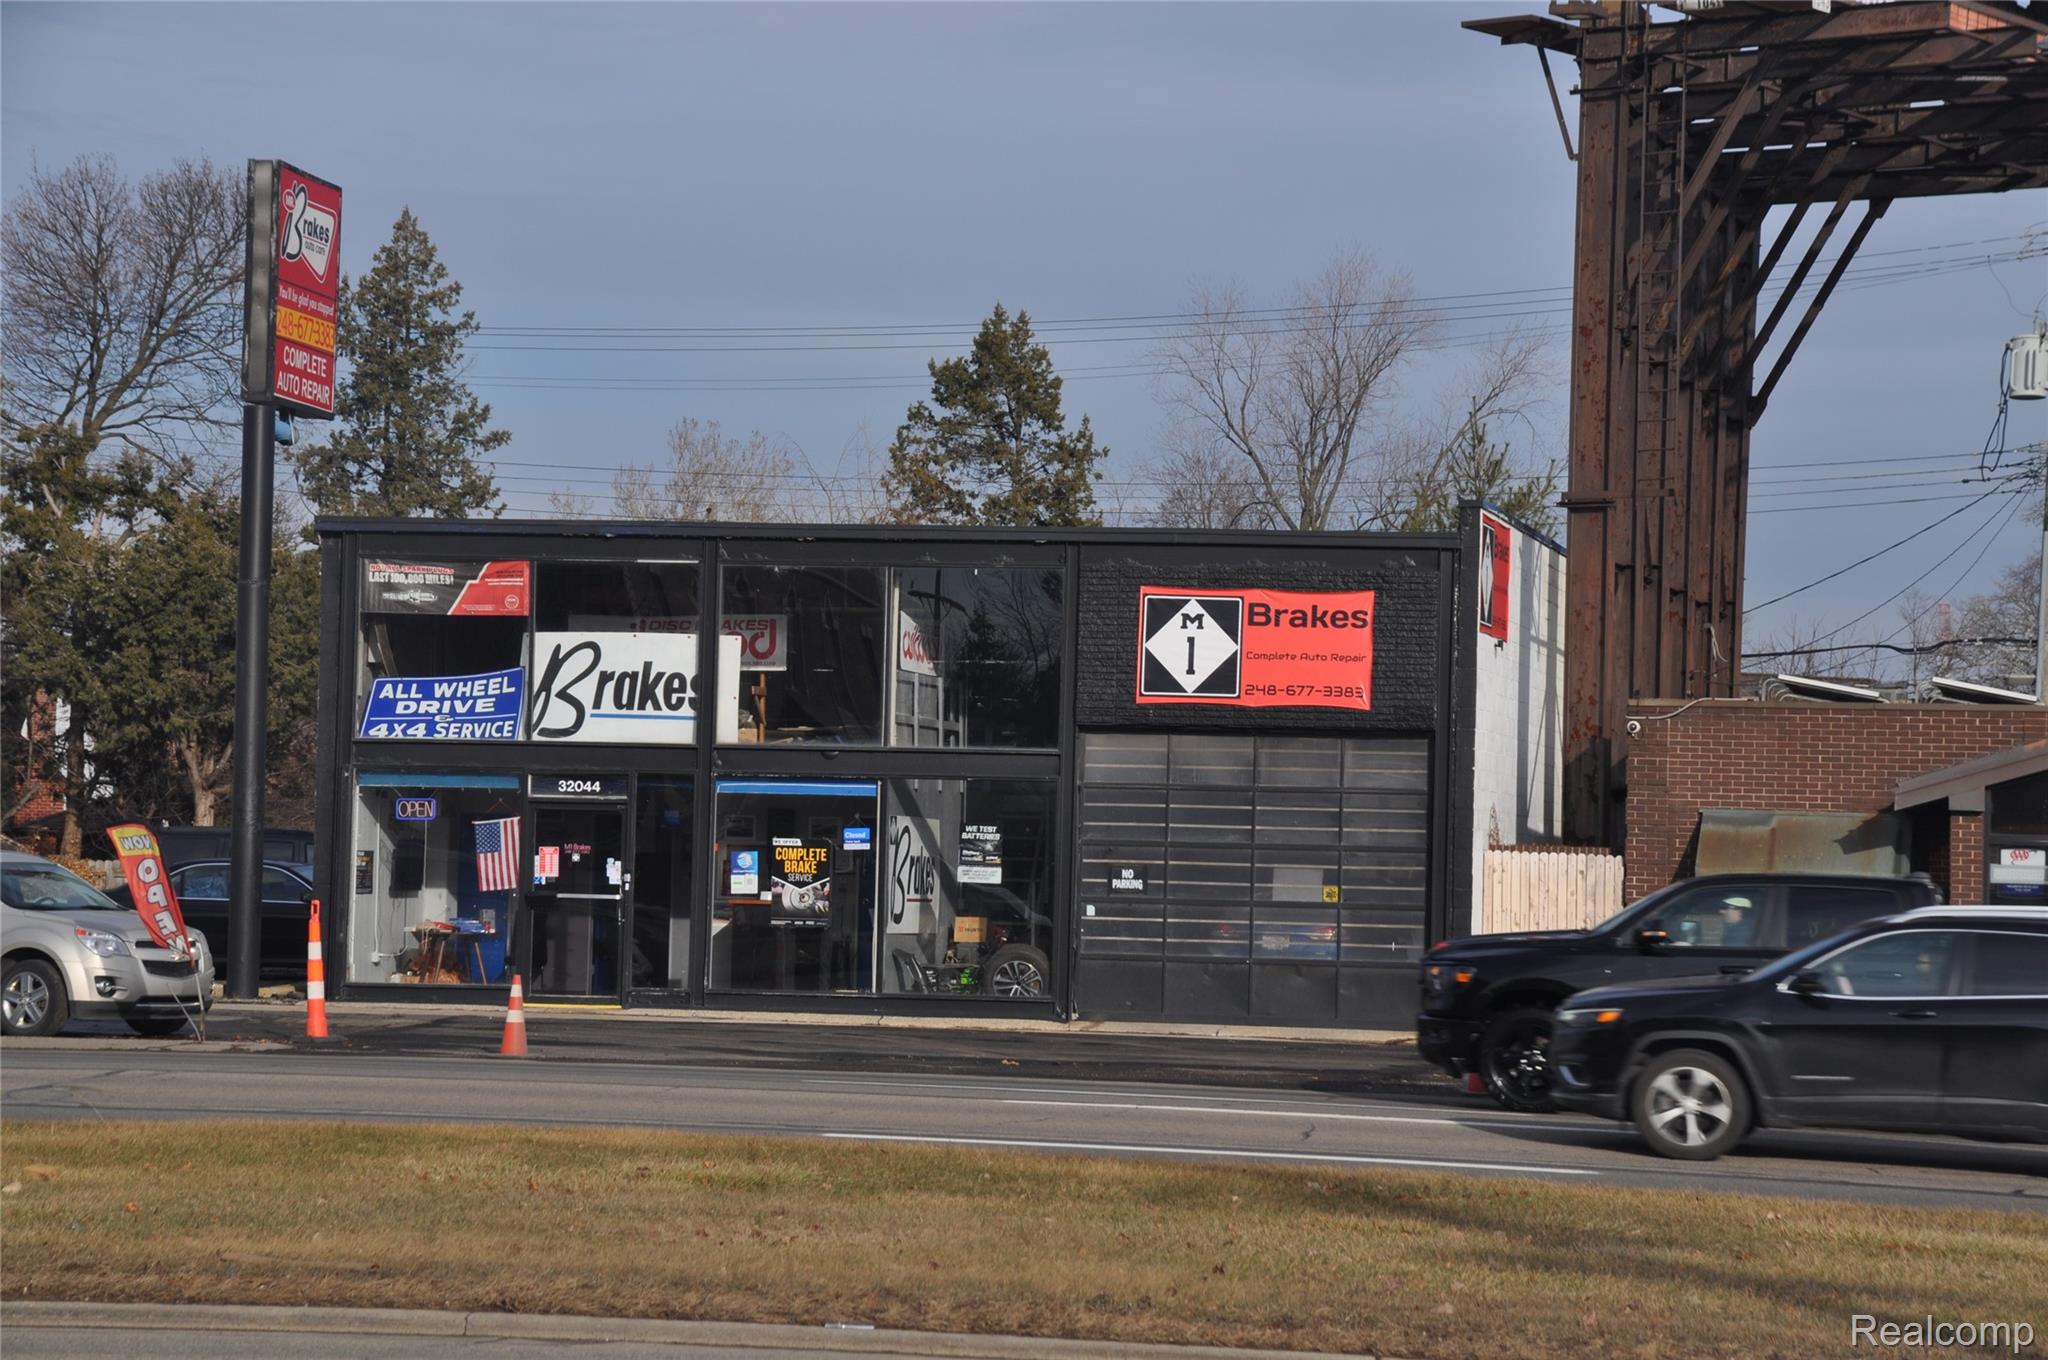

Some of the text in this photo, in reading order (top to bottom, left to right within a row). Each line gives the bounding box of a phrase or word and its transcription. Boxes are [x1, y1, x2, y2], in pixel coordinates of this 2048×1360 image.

[281, 182, 330, 259] Brakes
[283, 345, 327, 378] COMPLETE
[276, 370, 330, 405] AUTO REPAIR
[368, 572, 454, 585] LAST 100,000 MILES!
[1181, 613, 1204, 629] M
[1247, 602, 1369, 629] Brakes
[648, 619, 692, 631] DISC
[1246, 651, 1367, 664] Complete Auto Repair
[379, 676, 516, 699] ALL WHEEL
[1245, 684, 1364, 698] 248-677-3383
[395, 698, 496, 714] DRIVE
[368, 720, 515, 738] 4X4 SERVICE
[558, 780, 601, 793] 32044
[399, 801, 433, 817] OPEN
[961, 832, 1001, 840] BATTERIES
[979, 825, 998, 833] TEST
[573, 842, 592, 850] Brakes
[775, 847, 828, 862] COMPLETE
[784, 861, 817, 873] BRAKE
[1122, 869, 1134, 879] NO
[787, 873, 813, 882] SERVICE
[890, 825, 935, 925] Brakes
[1112, 879, 1143, 890] PARKING
